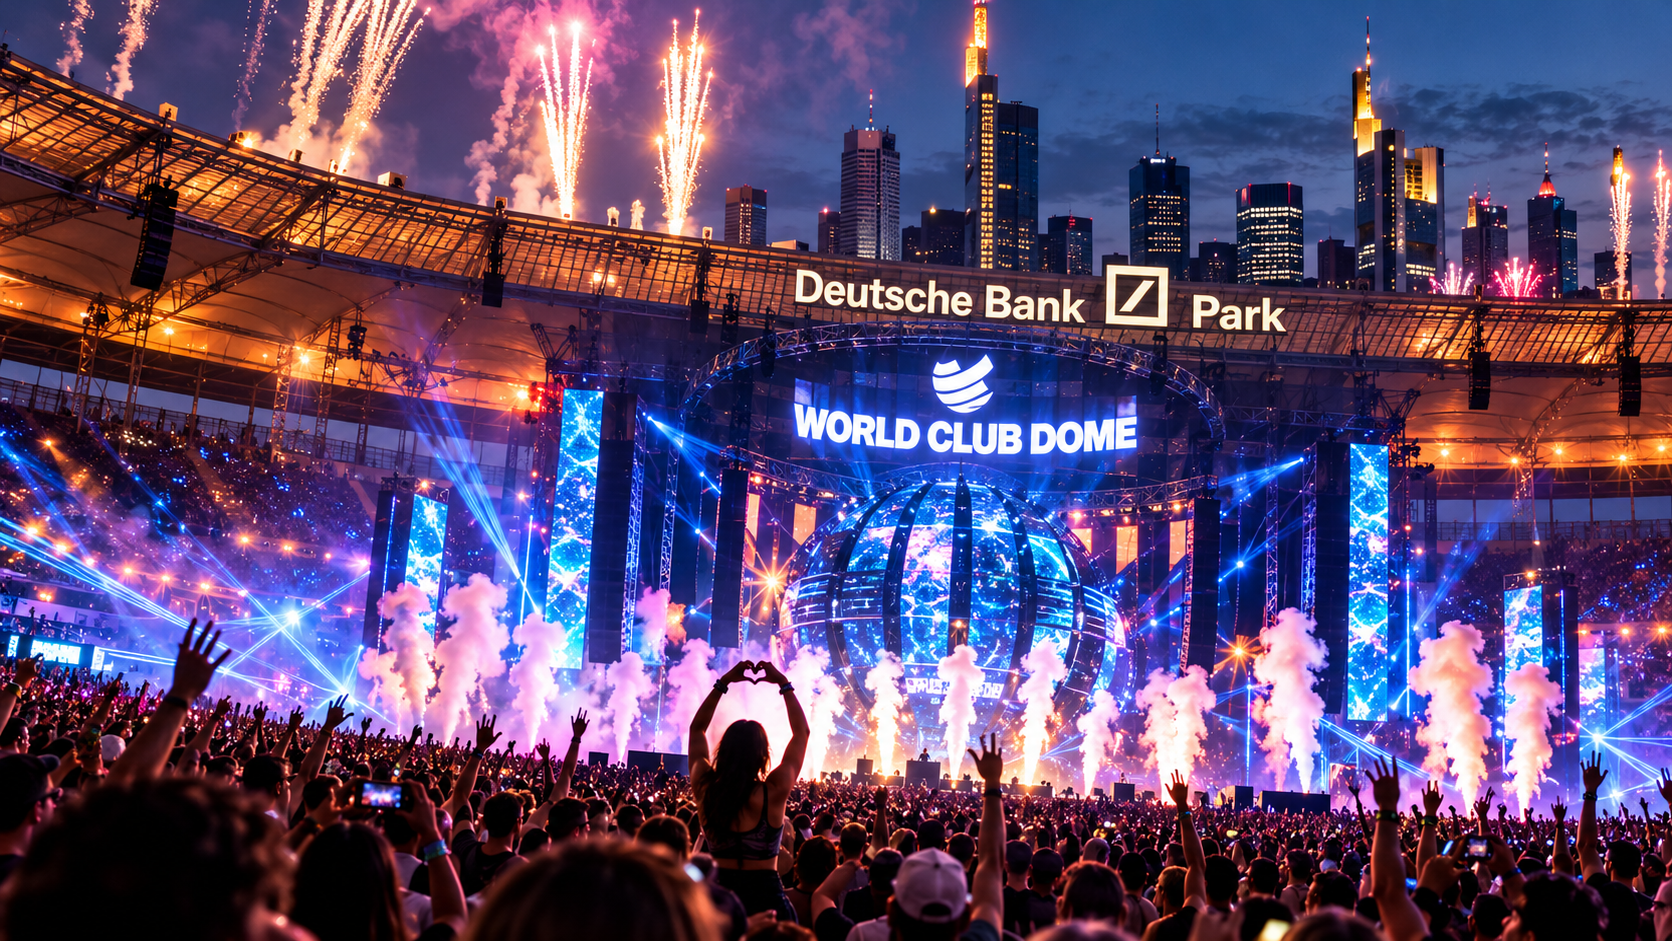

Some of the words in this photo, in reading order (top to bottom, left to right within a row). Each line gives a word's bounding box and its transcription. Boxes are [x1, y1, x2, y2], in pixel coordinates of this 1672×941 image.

[795, 268, 973, 317] Deutsche
[985, 284, 1086, 323] Bank
[1192, 294, 1288, 332] Park
[794, 403, 921, 450] WORLD
[927, 420, 1025, 455] CLUB
[1030, 418, 1138, 455] DOME
